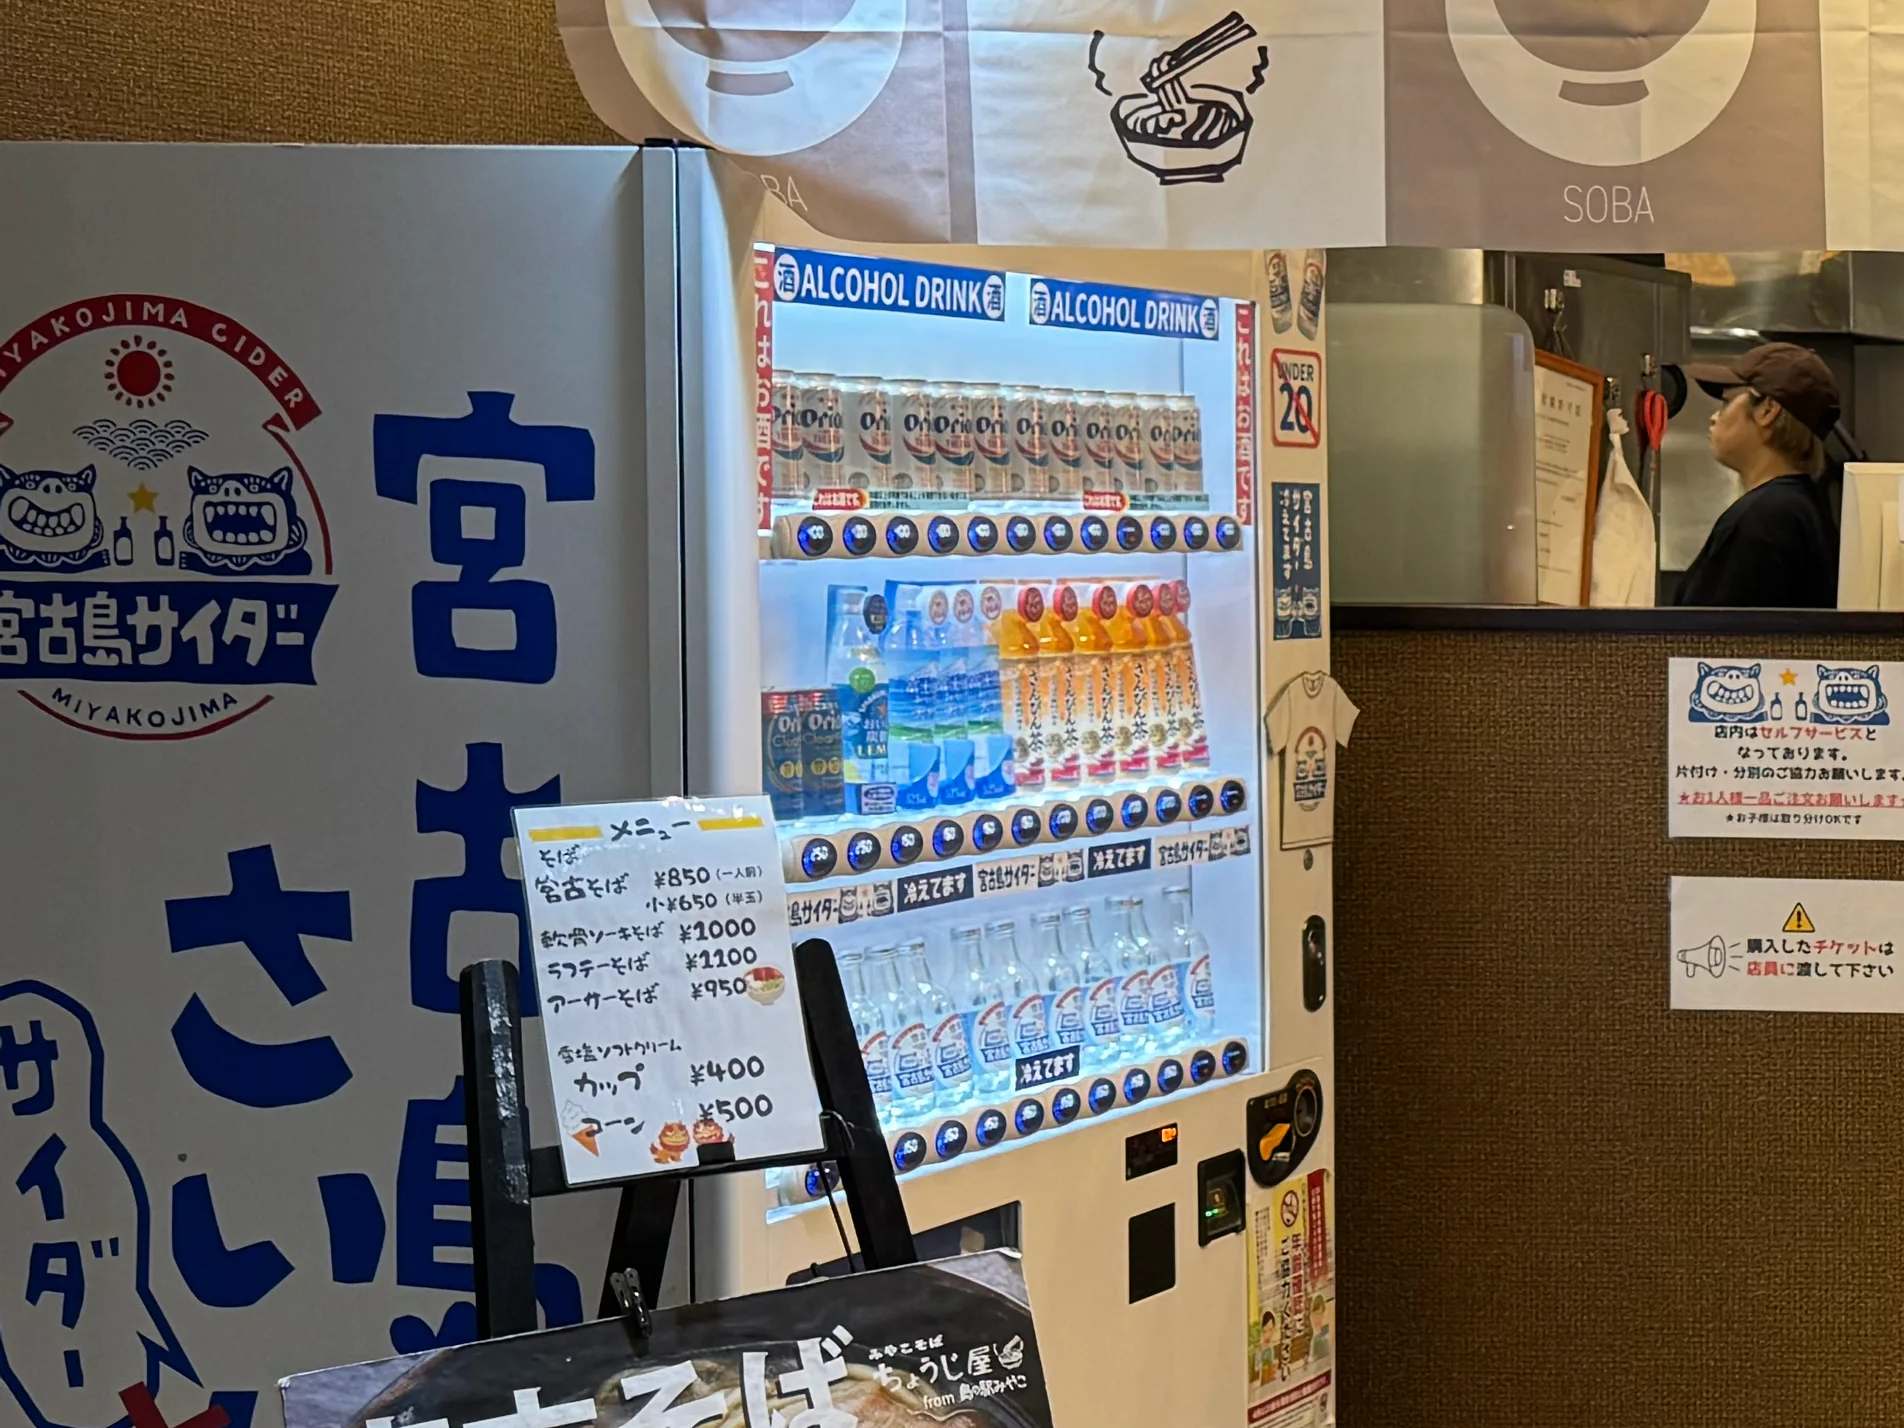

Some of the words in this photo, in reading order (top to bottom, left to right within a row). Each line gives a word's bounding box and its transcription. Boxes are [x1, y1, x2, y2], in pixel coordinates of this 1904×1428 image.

[760, 174, 809, 212] BA
[1562, 183, 1656, 226] SOBA
[801, 263, 909, 308] ALCOHOL
[914, 272, 984, 316] DRINK
[1051, 289, 1143, 329] ALCOHOL
[1144, 298, 1200, 335] DRINK
[210, 321, 305, 410] CIDER
[1277, 362, 1314, 382] UNDER
[1279, 382, 1313, 433] 20
[51, 687, 239, 729] MIYAKOJIMA
[1714, 725, 1877, 740] 店内はセルフサービスと
[1737, 745, 1849, 761] なっております。
[611, 817, 692, 842] メニュー
[539, 843, 581, 866] そば
[1092, 845, 1147, 870] 冷えてます
[535, 872, 630, 904] 宮古そば
[653, 866, 712, 887] ¥850
[903, 873, 967, 904] 冷えてます
[978, 863, 1036, 892] 宮古島サイダー
[540, 922, 664, 950] 軟骨ソーキそば
[679, 916, 757, 943] ¥1000
[1746, 938, 1895, 956] 購入したチケットは
[548, 951, 650, 980] ラフテーそば
[685, 946, 758, 970] ¥1100
[1746, 961, 1895, 979] 店員に渡して下さい
[547, 982, 661, 1014] アーサーそば
[690, 976, 748, 1000] ¥950
[573, 1062, 646, 1098] カップ
[690, 1055, 766, 1086] ¥400
[1020, 1052, 1076, 1084] 冷えてます
[699, 1093, 774, 1122] ¥500
[868, 1333, 944, 1362] みやこそば
[873, 1346, 994, 1395] ちょうじ屋
[923, 1391, 955, 1412] from
[958, 1374, 1029, 1404] 島の駅みやこ
